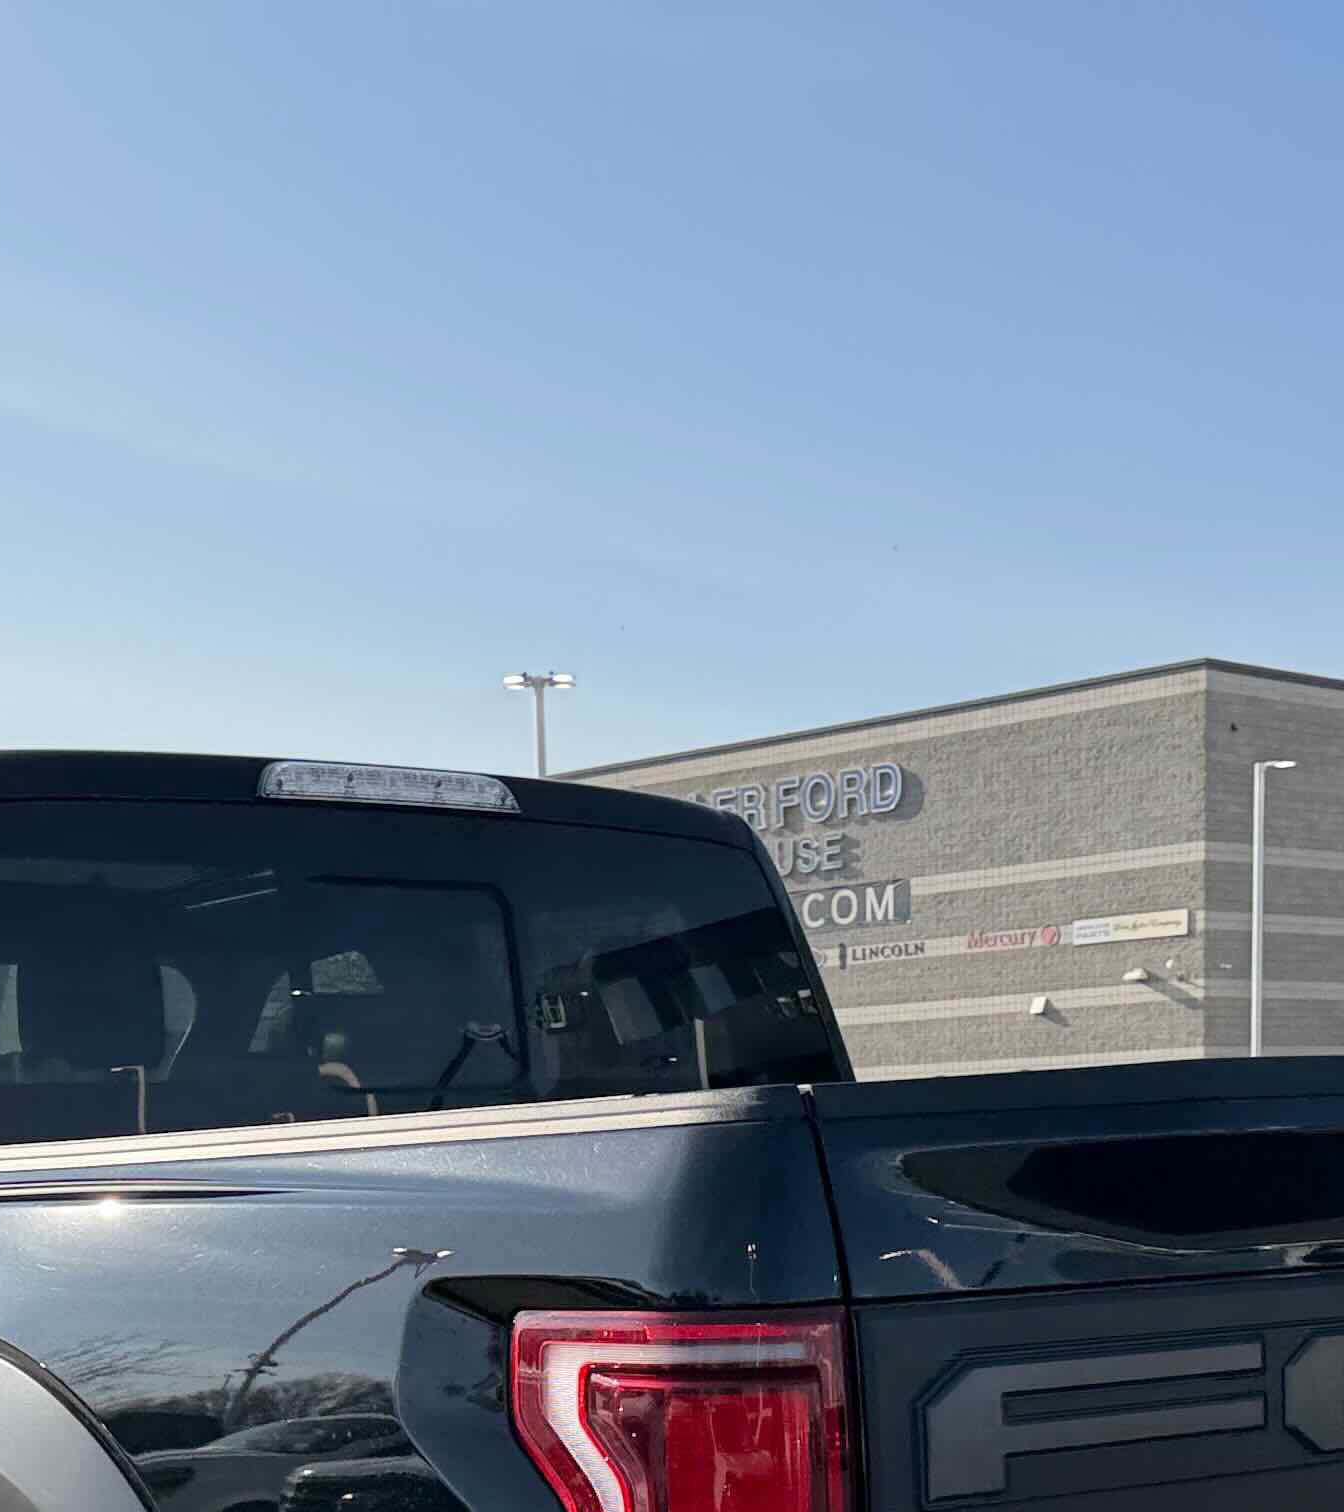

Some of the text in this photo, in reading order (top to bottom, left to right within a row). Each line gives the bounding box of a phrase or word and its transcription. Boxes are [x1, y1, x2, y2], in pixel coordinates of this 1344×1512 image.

[774, 762, 903, 829] FORD
[967, 925, 1040, 950] Mercury
[851, 941, 926, 961] LINCOLN
